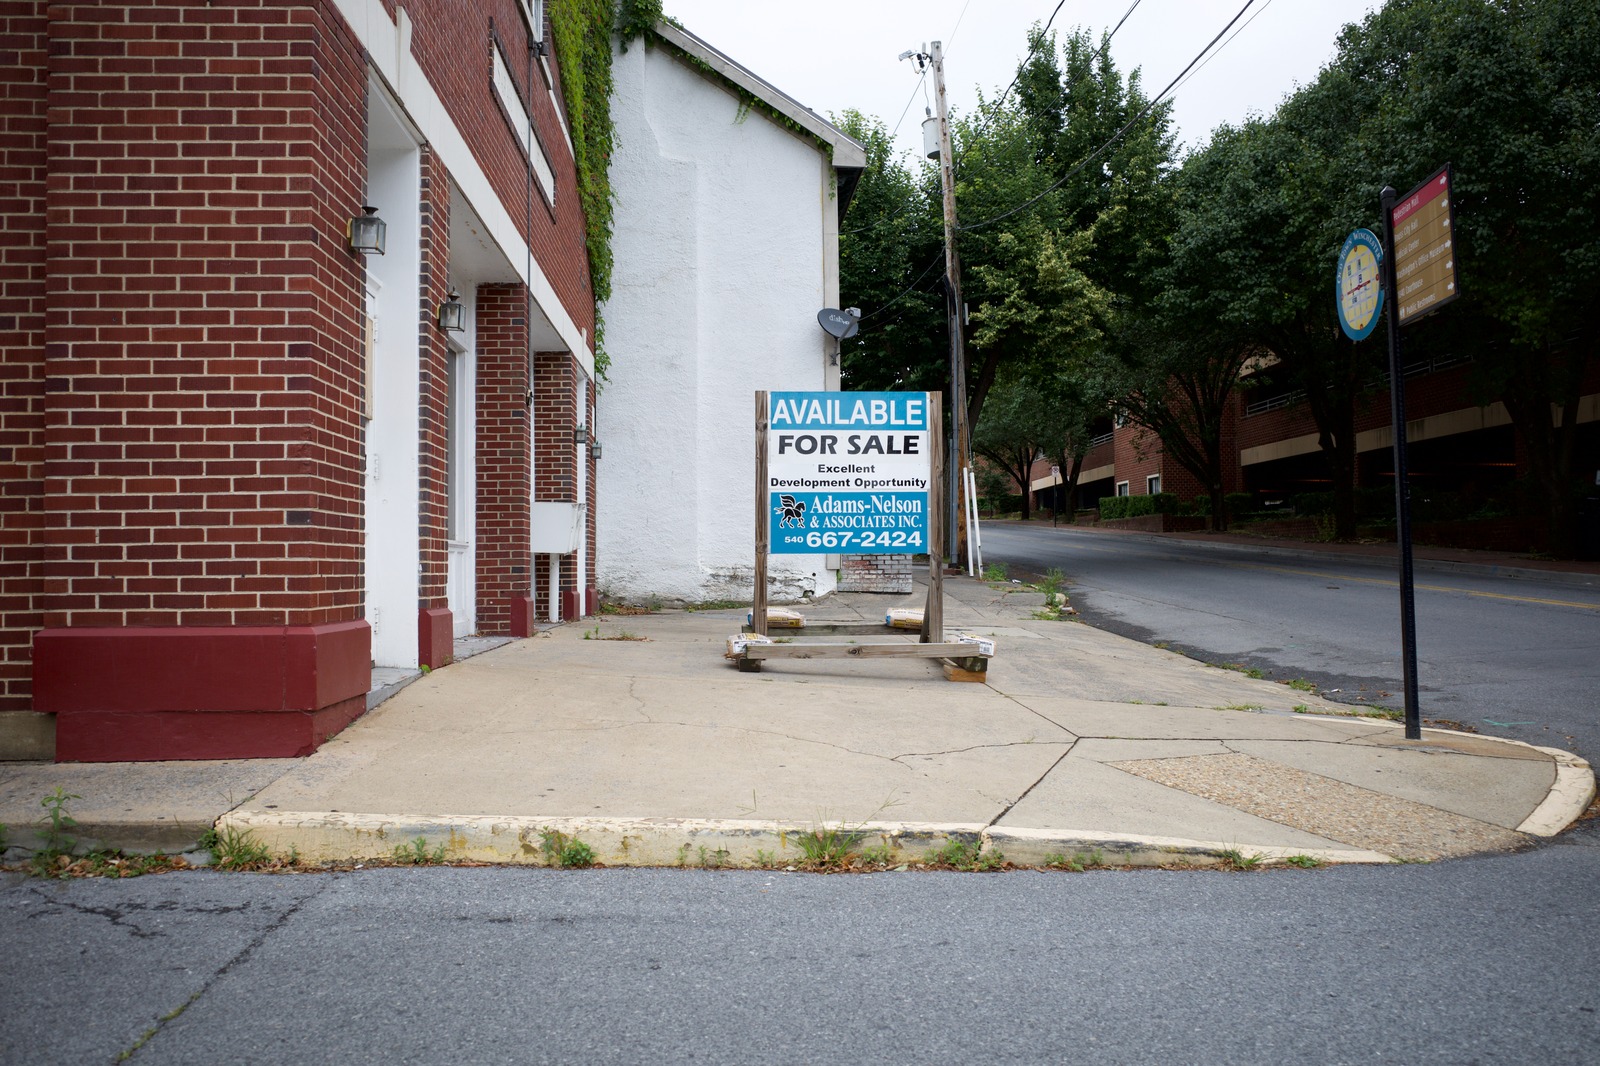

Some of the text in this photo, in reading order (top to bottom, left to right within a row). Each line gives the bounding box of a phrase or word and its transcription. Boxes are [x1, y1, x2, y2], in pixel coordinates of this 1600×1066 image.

[1411, 195, 1419, 208] Mall
[771, 399, 923, 425] AVAILABLE
[778, 435, 920, 455] FOR SALE
[817, 464, 876, 473] Excellent
[770, 478, 927, 489] Development Opportunity
[810, 495, 922, 514] Adams-Nelson
[809, 515, 923, 529] & ASSOCIATES INC.
[784, 531, 923, 548] 540 667-2424
